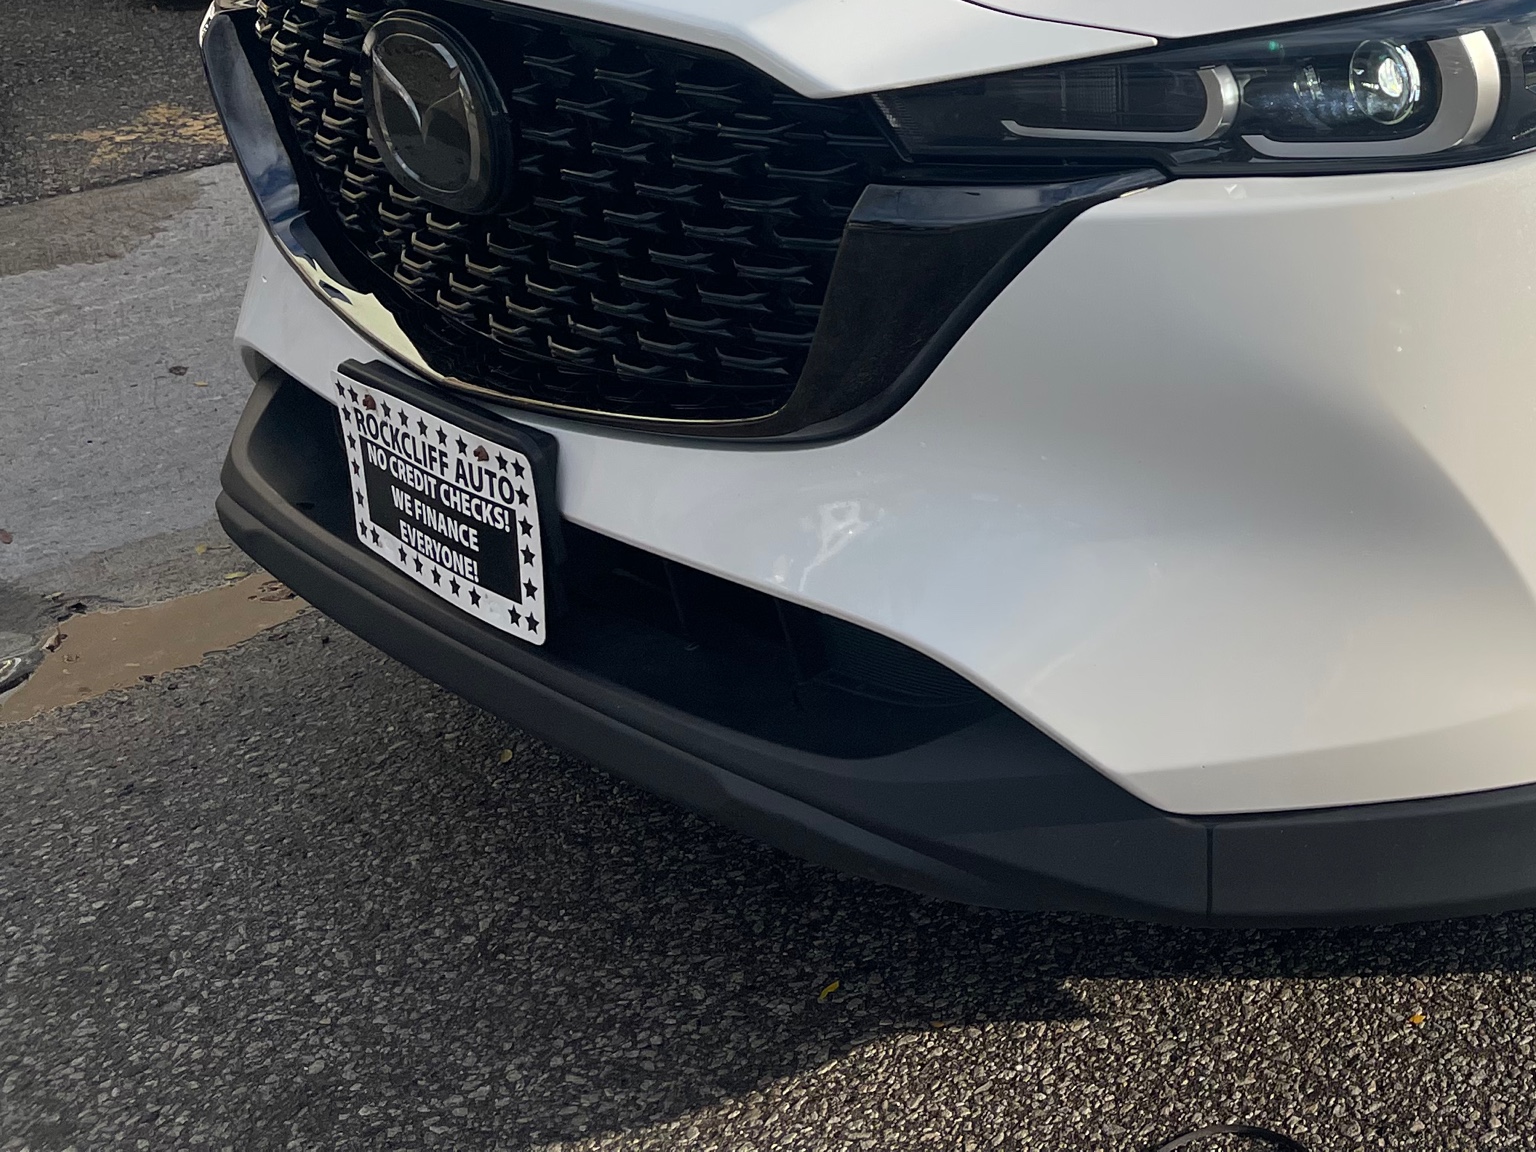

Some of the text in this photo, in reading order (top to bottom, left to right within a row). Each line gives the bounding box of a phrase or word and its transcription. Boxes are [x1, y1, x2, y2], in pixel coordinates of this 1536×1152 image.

[354, 406, 515, 506] ROCKCLIFF AUTO
[366, 442, 512, 533] NO CREDIT CHECKS!
[391, 484, 480, 552] WE FINANCE
[399, 518, 480, 583] EVERYONE!
